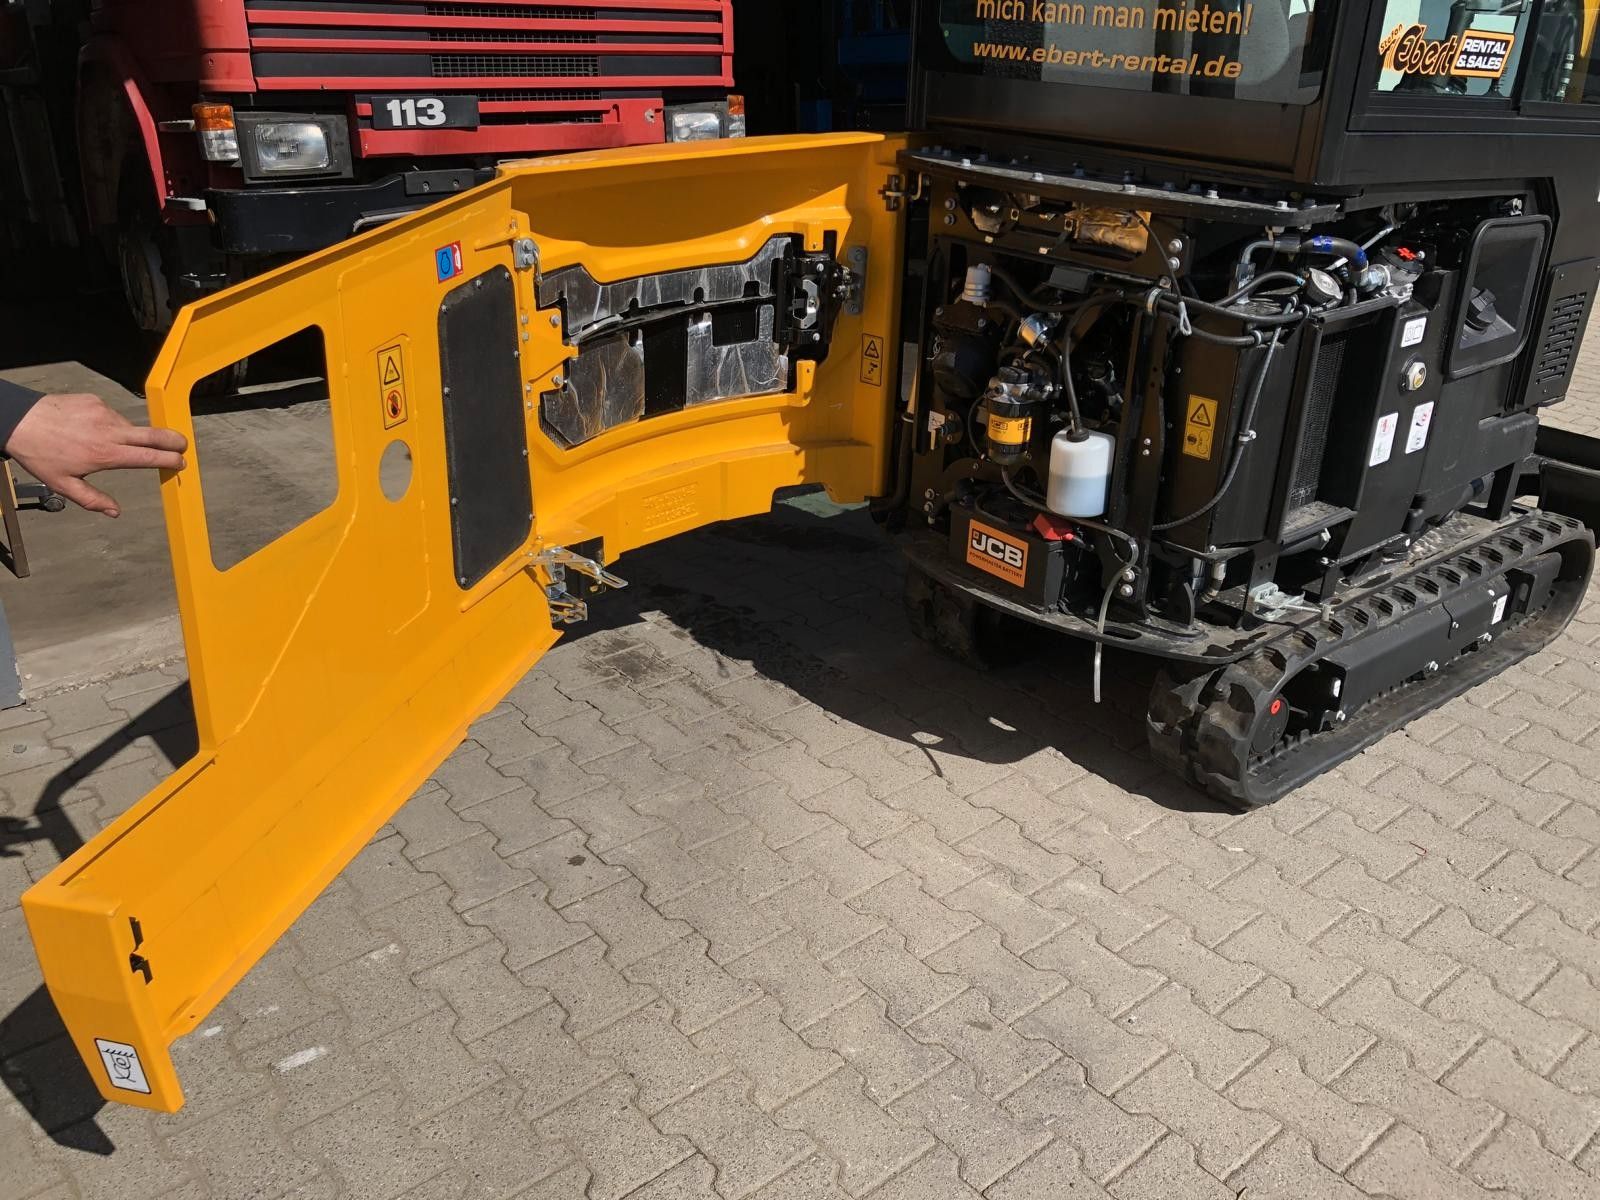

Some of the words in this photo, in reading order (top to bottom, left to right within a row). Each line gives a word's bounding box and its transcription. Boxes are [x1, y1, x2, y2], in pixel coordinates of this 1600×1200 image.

[976, 0, 1025, 21] mich
[1031, 0, 1086, 25] kann
[1092, 4, 1145, 28] man
[1152, 0, 1253, 35] mieten!
[973, 42, 1244, 78] www.ebert-rental.de
[1393, 24, 1458, 75] Ebert
[1462, 38, 1507, 55] RENTAL
[1466, 55, 1503, 70] SALES
[386, 98, 447, 126] 113
[972, 532, 1023, 569] JCB
